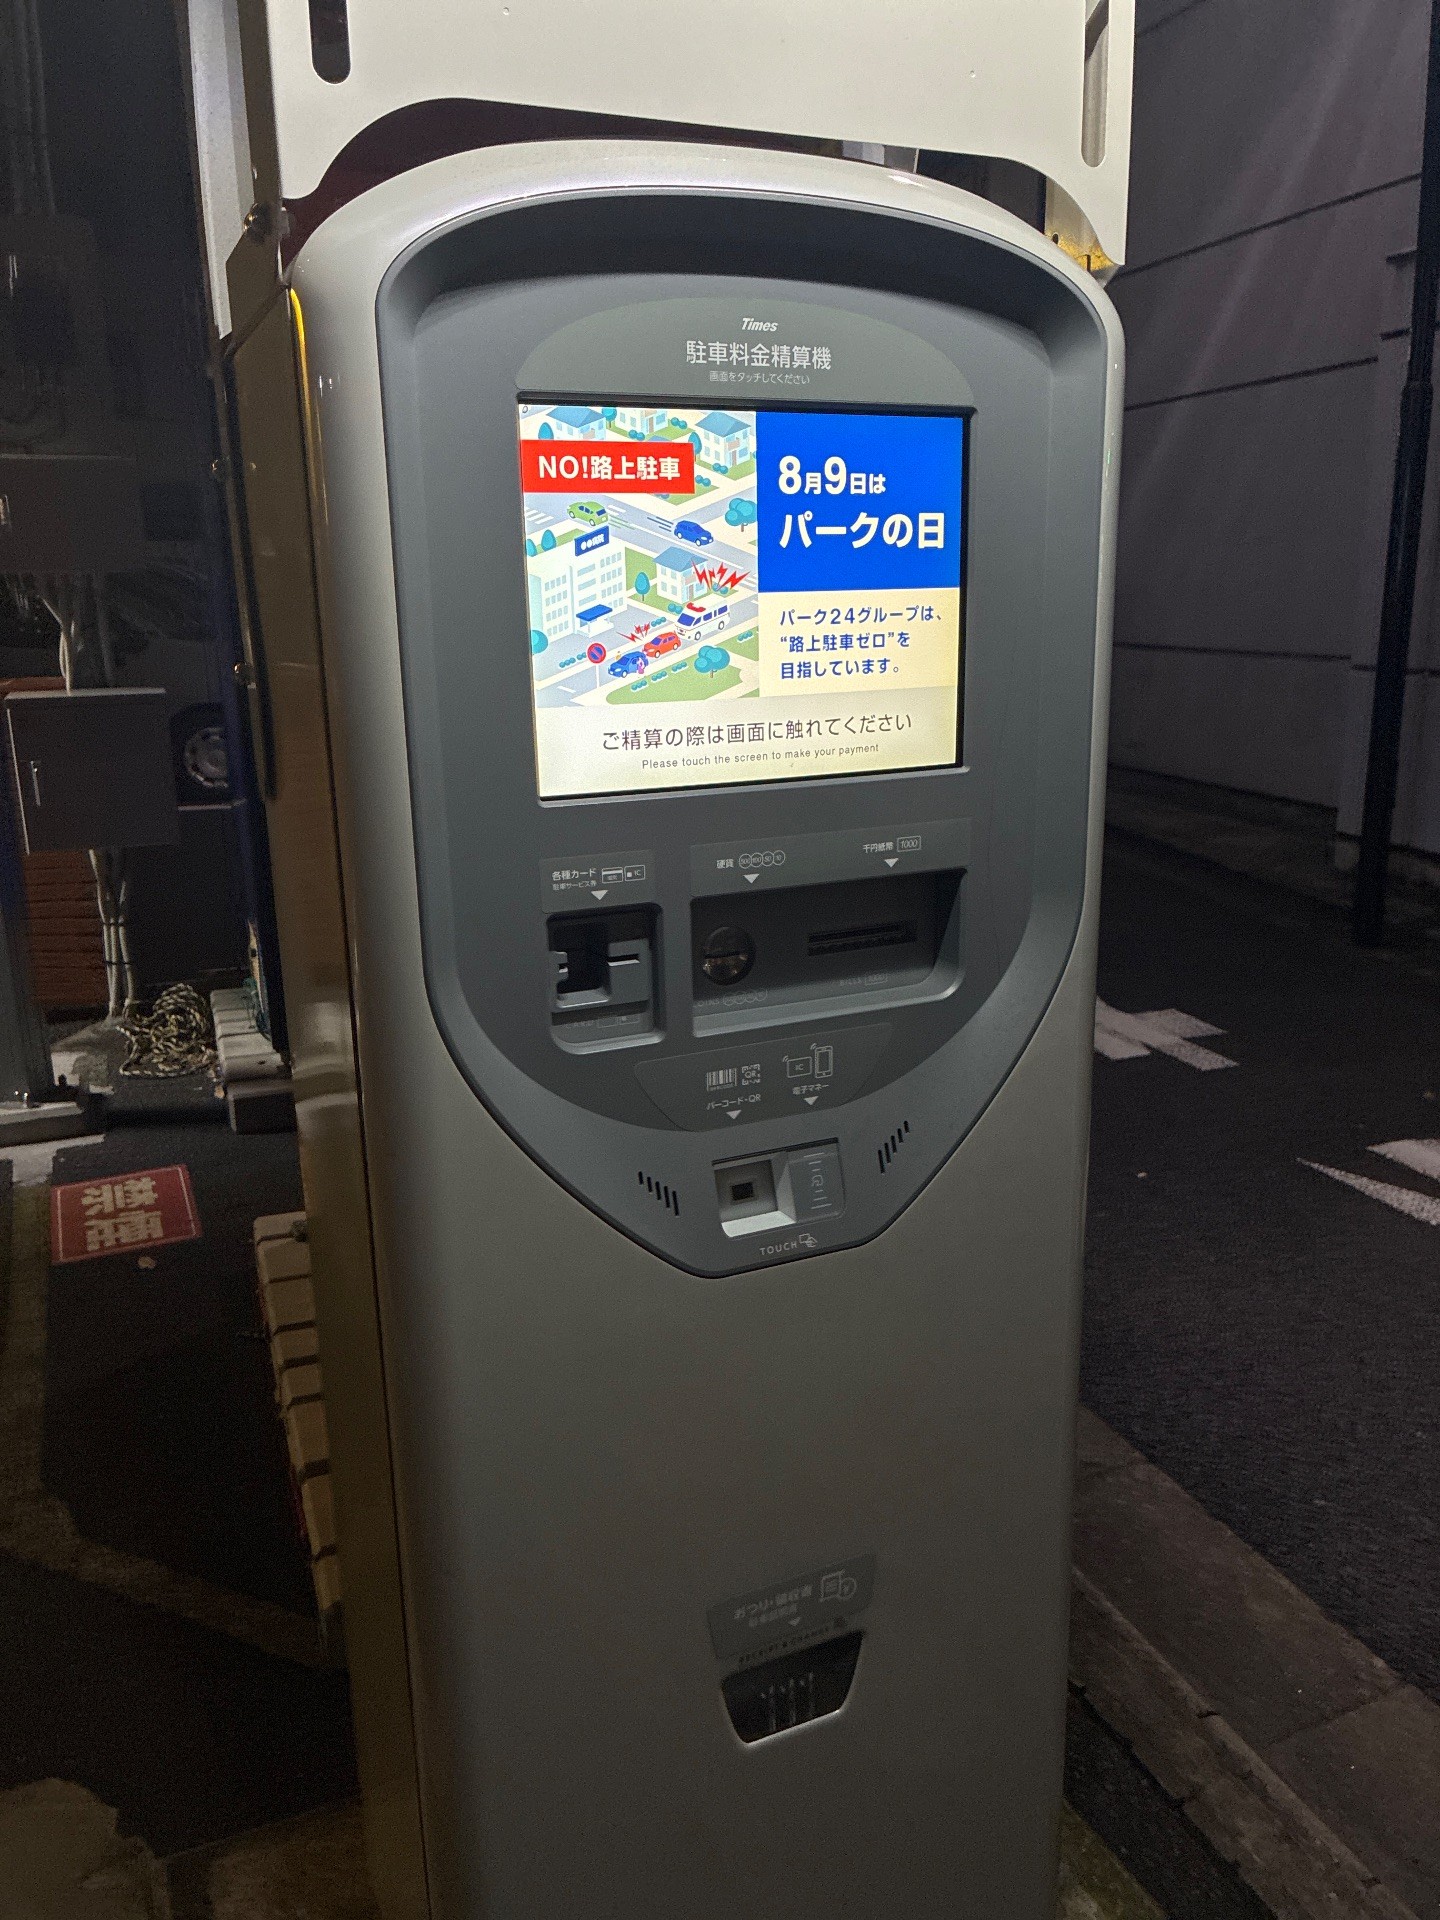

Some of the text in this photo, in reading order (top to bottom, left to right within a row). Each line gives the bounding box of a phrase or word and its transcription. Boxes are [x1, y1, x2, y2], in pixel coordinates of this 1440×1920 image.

[741, 317, 778, 332] Times
[685, 339, 832, 371] 駐車料金精算機
[709, 371, 810, 385] 画面をタッチしてください
[538, 455, 681, 482] NO!路上駐車
[778, 455, 887, 495] 8月9日は
[779, 512, 946, 550] パークの日
[779, 605, 942, 626] パーク24グループは、
[781, 657, 900, 680] 目指しています。
[601, 713, 913, 752] ご精算の際は画面に触れてください
[642, 743, 879, 769] Please touch the screen to make your payment
[552, 868, 597, 881] 各種カード
[716, 858, 734, 869] 硬貨
[706, 1094, 761, 1110] バーコード・QR
[759, 1241, 797, 1256] TOUCH
